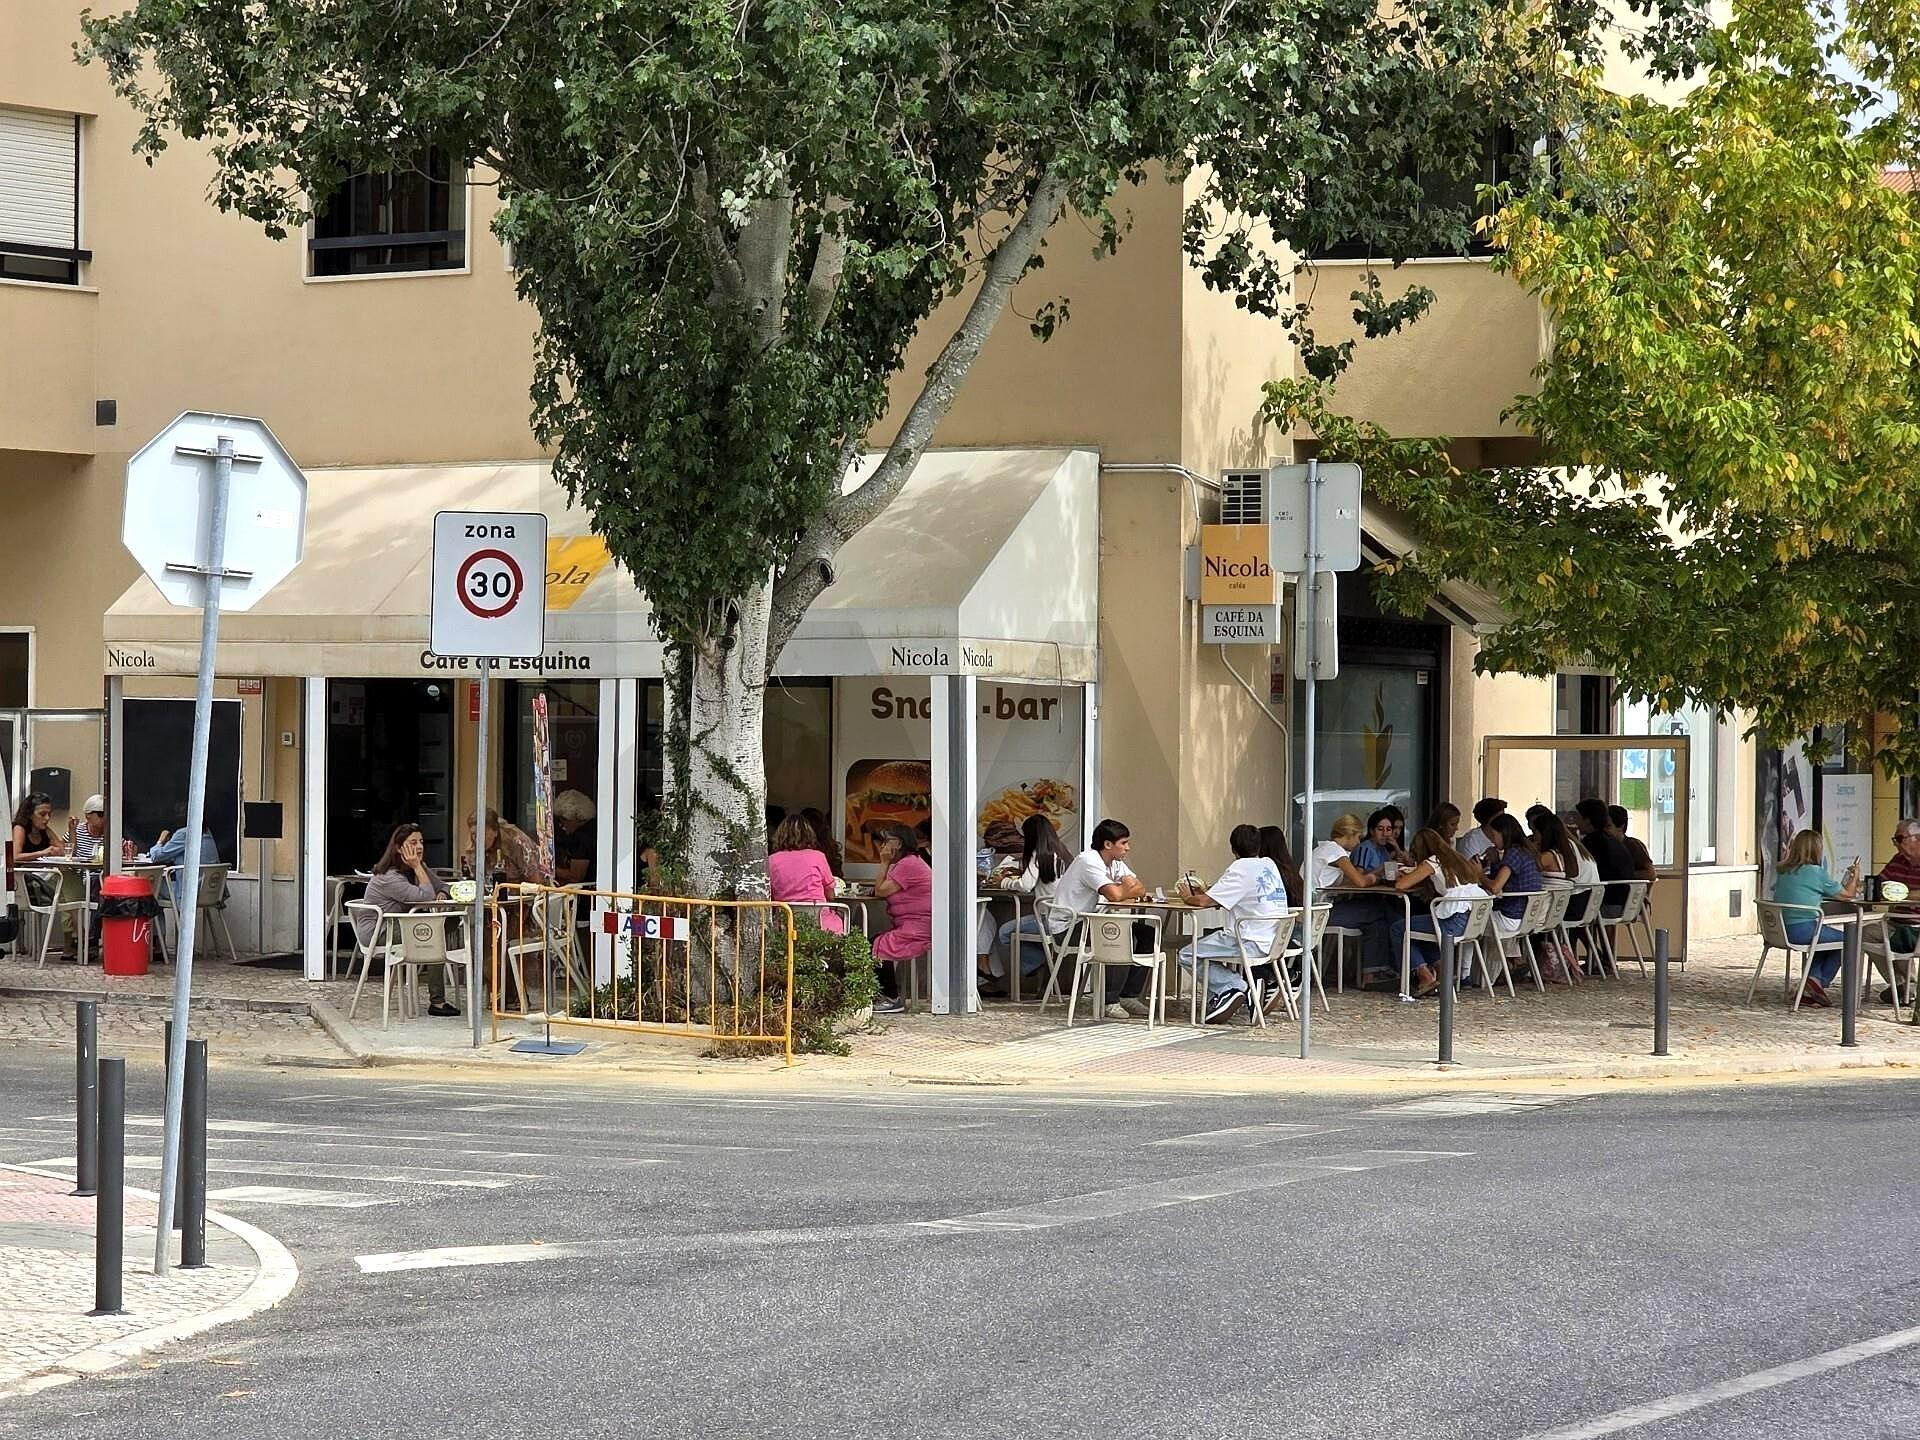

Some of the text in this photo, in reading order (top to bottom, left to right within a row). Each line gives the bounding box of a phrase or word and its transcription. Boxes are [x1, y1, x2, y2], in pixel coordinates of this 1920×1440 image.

[464, 522, 516, 539] zona
[1205, 555, 1270, 578] Nicola
[470, 571, 512, 599] 30
[1215, 608, 1264, 623] CAFÉ DA
[1214, 625, 1265, 639] ESQUINA
[108, 649, 156, 669] Nicola
[508, 651, 591, 676] Esquina
[892, 646, 950, 667] Nicola
[963, 646, 993, 668] Nicola
